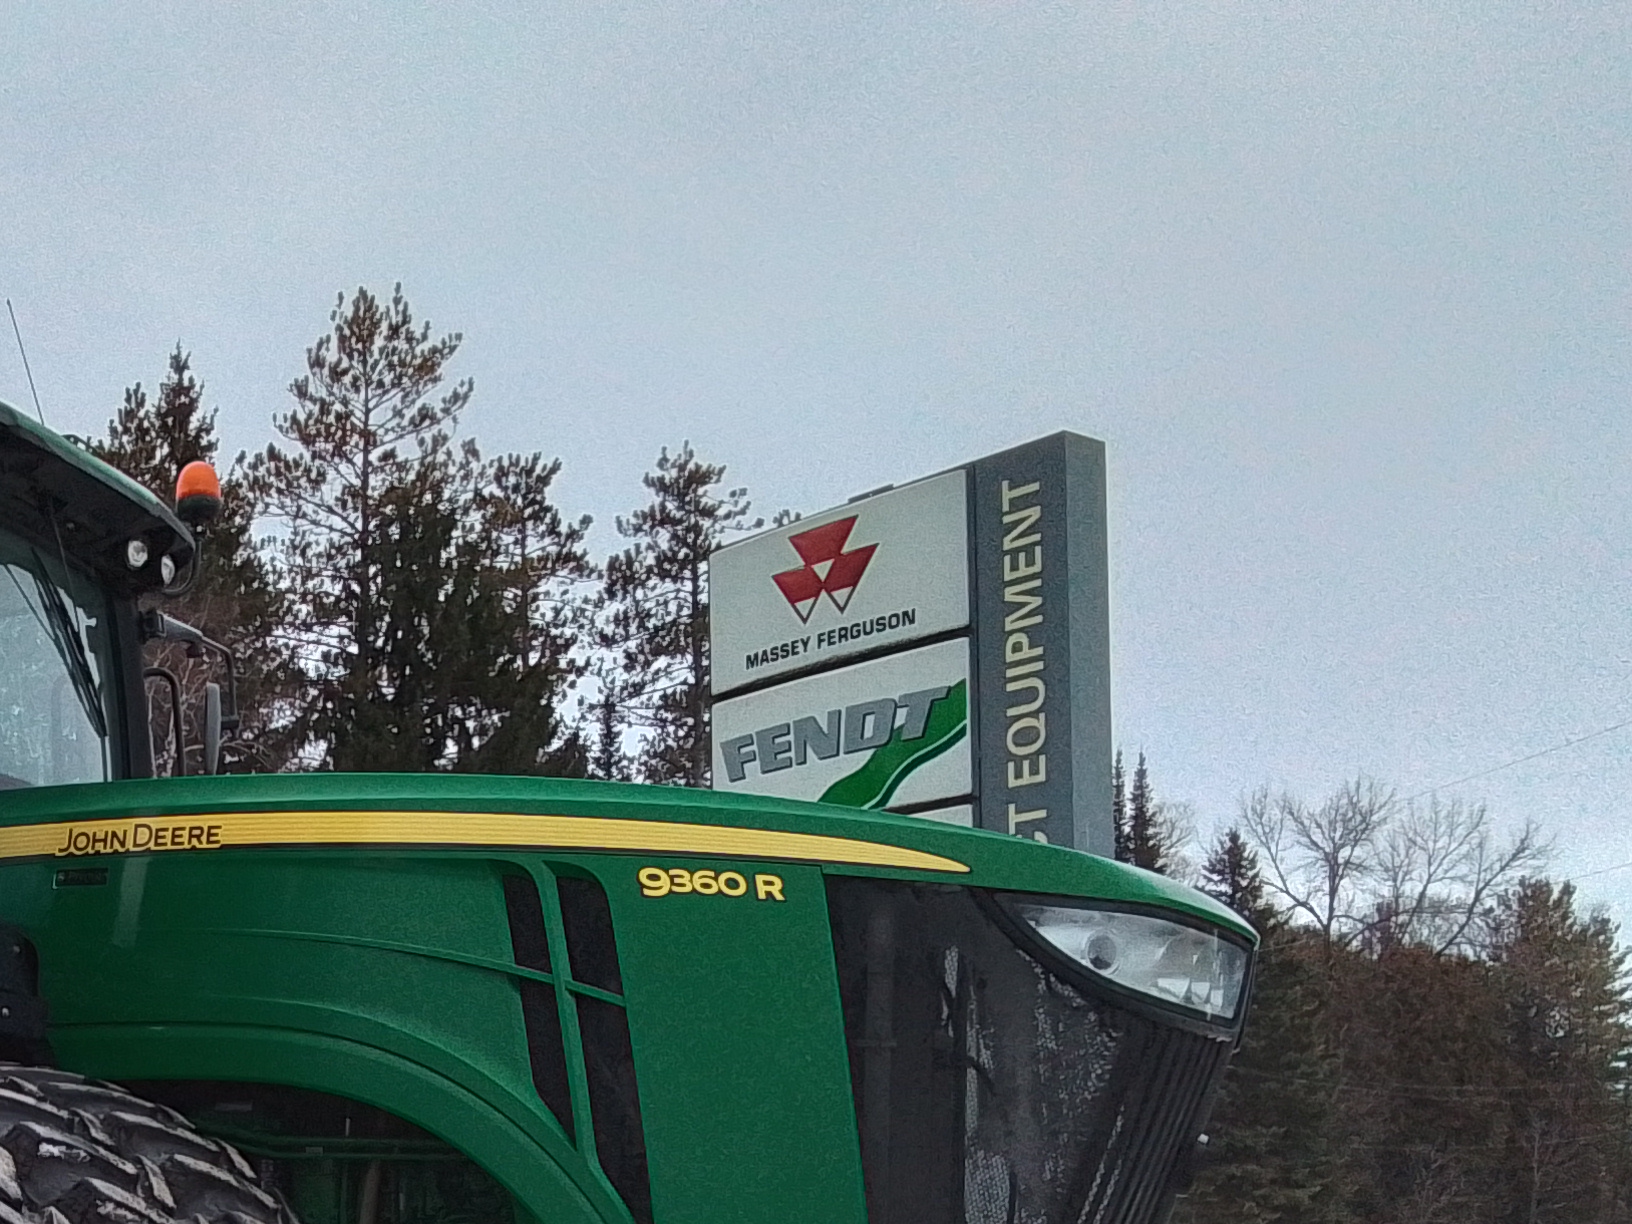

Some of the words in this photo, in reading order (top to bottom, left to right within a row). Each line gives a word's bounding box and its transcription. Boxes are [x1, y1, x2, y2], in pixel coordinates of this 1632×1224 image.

[745, 635, 811, 670] MASSEY
[816, 607, 916, 650] FERGUSON
[1001, 480, 1046, 789] EQUIPMENT
[719, 685, 951, 783] FENDT
[57, 827, 128, 854] JOHN
[132, 823, 223, 849] DEERE
[637, 866, 748, 898] 9360
[754, 873, 787, 901] R
